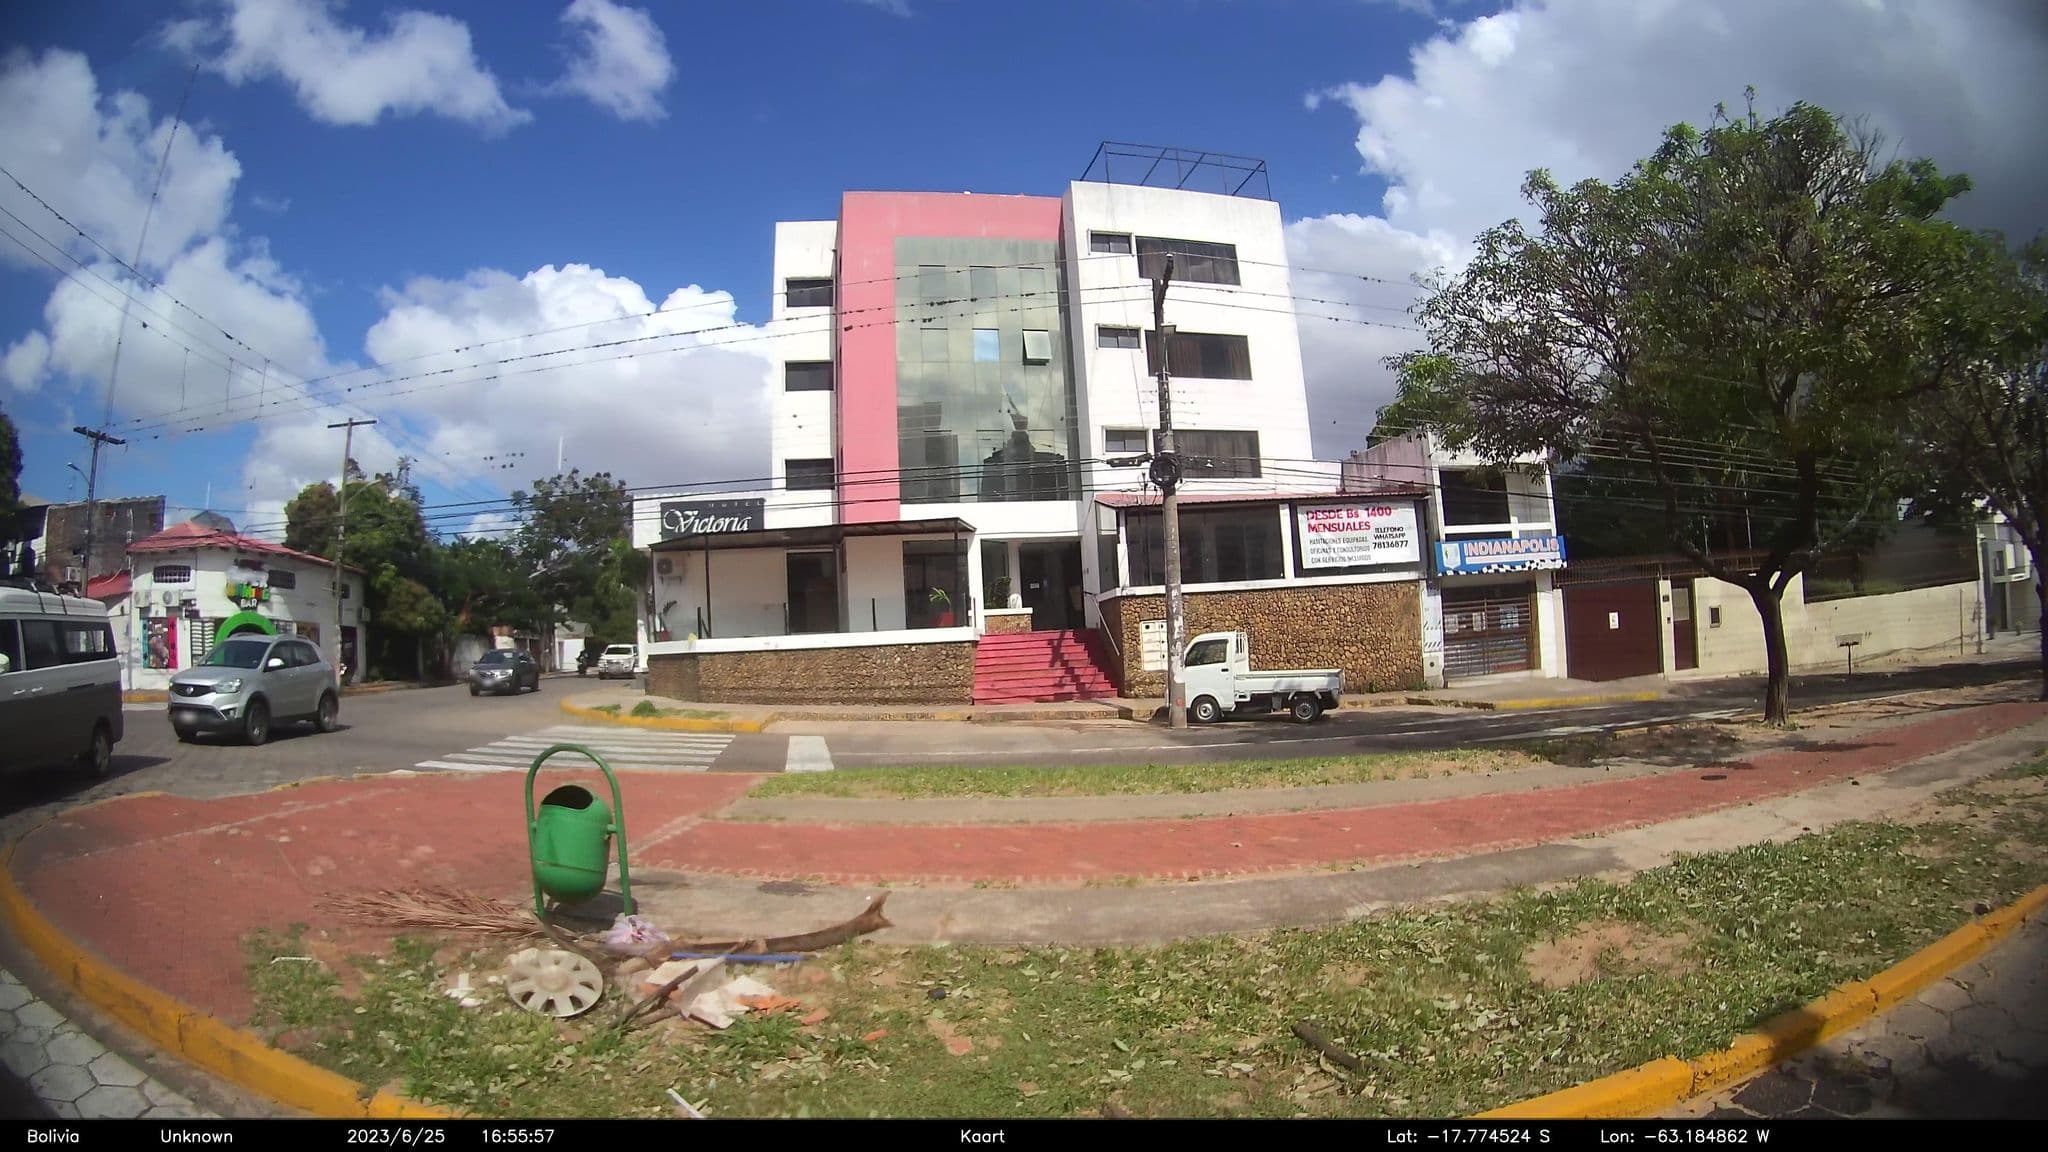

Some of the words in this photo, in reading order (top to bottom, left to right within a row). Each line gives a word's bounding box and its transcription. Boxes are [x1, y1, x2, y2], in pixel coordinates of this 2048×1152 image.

[1307, 508, 1343, 520] DESDE
[1347, 508, 1359, 518] Bs
[1365, 506, 1392, 517] 1400
[663, 509, 752, 533] Victoria
[1308, 521, 1371, 533] MENSUALES
[1374, 532, 1406, 540] WHATSAPP
[1464, 538, 1559, 556] INDIANAPOLIS
[241, 598, 257, 608] BAR
